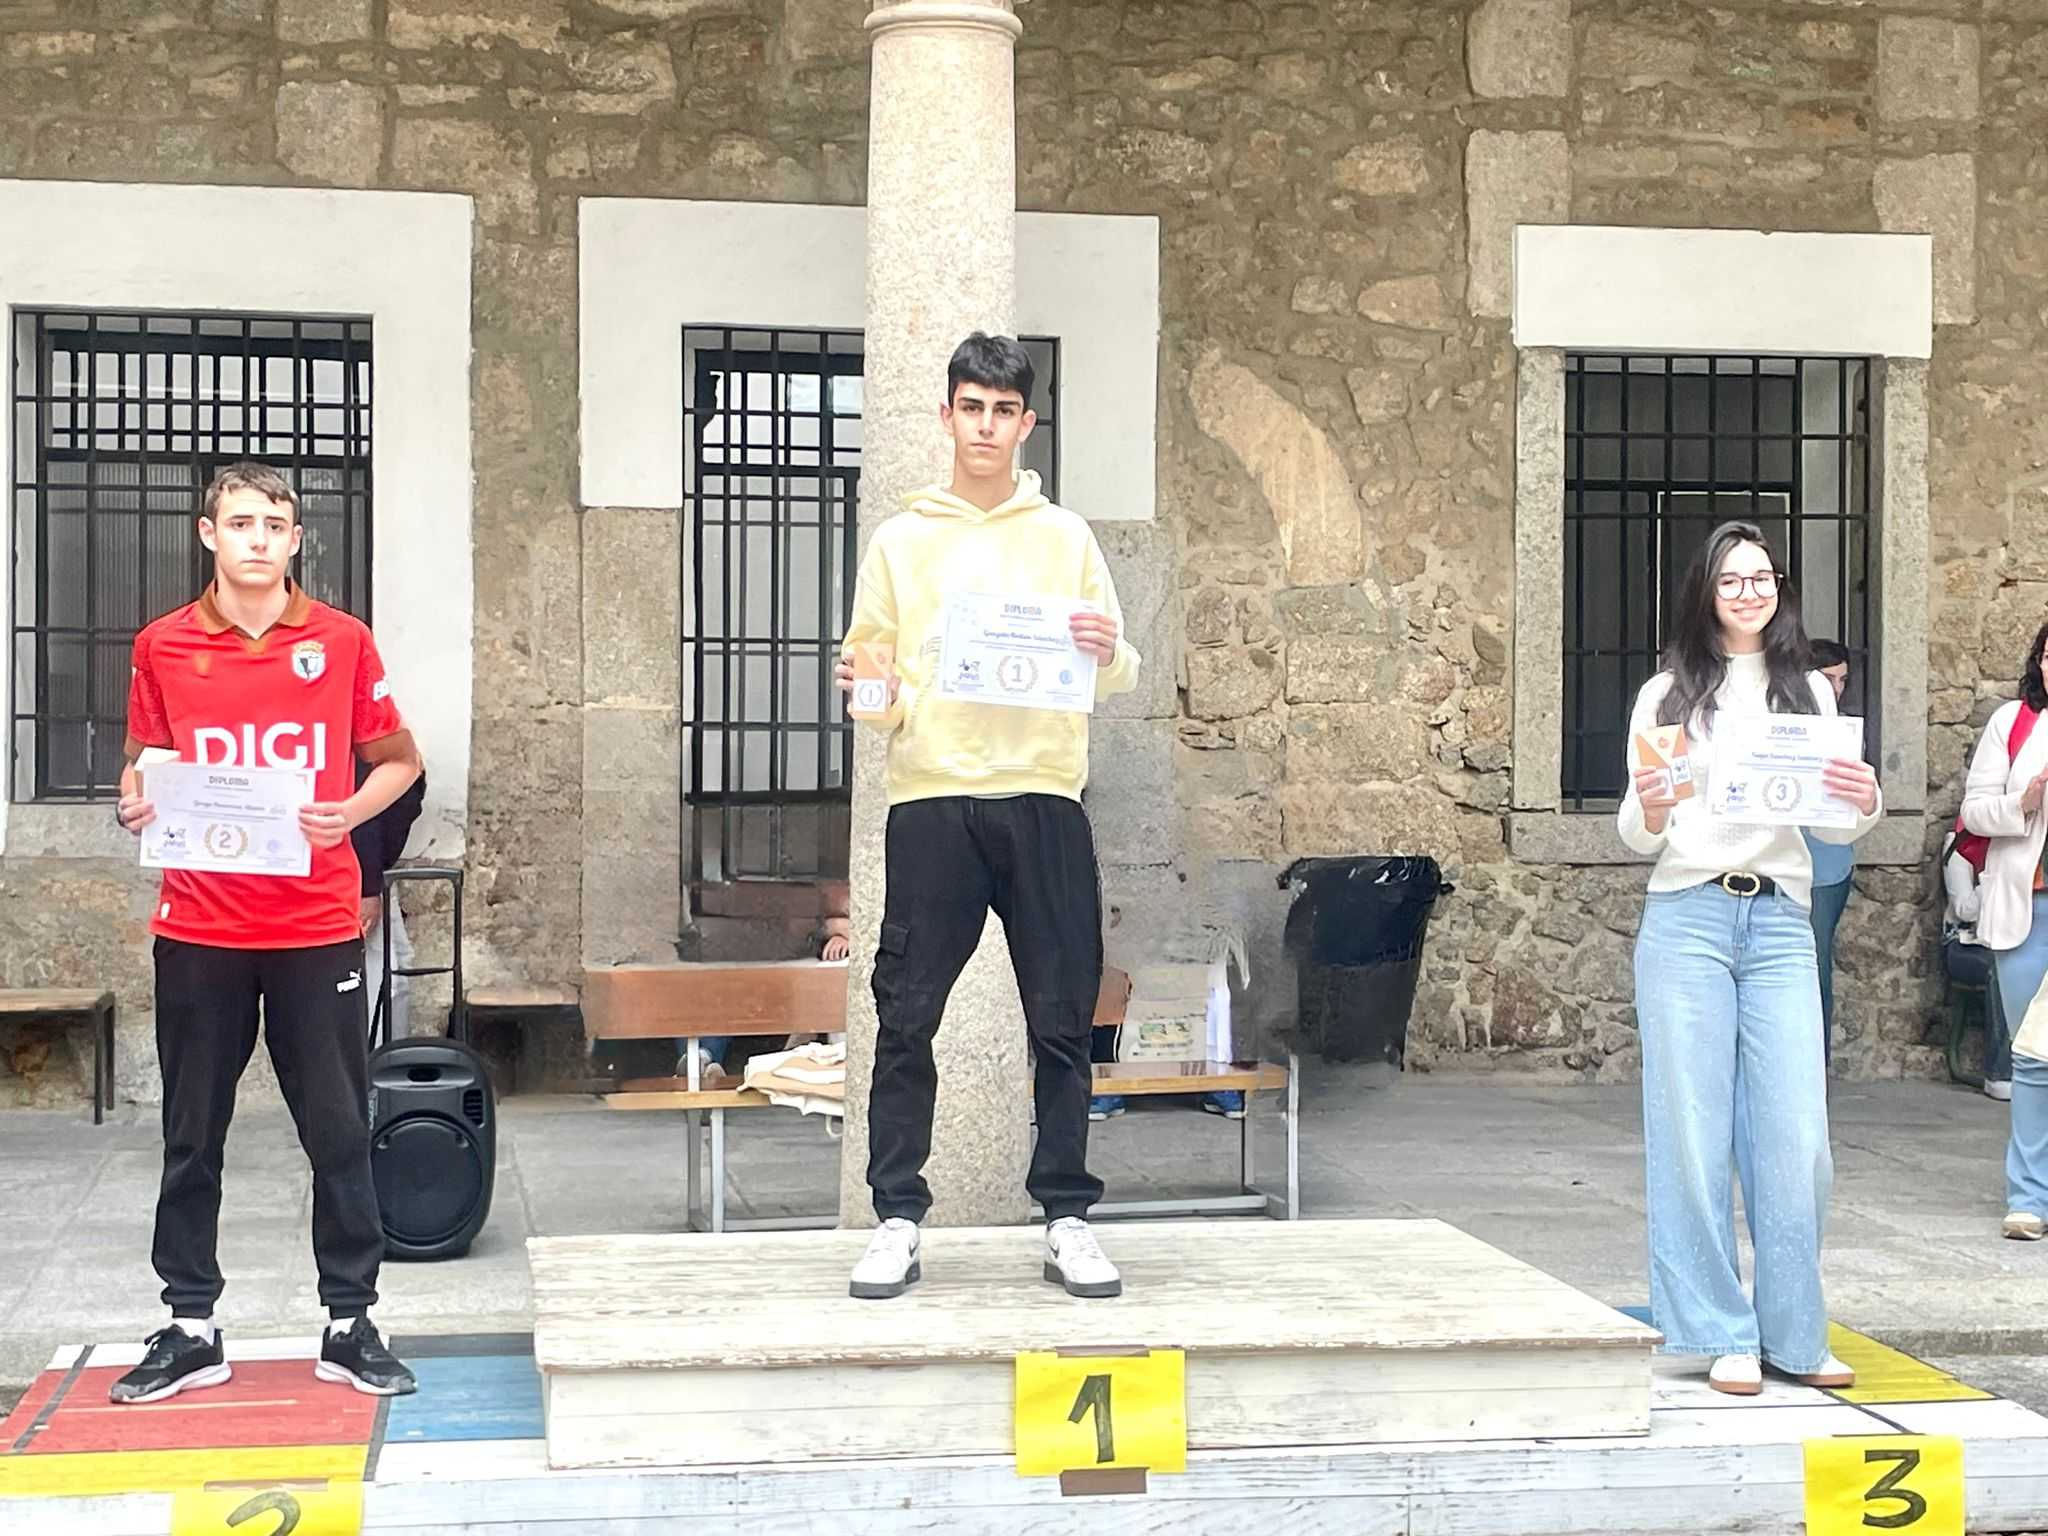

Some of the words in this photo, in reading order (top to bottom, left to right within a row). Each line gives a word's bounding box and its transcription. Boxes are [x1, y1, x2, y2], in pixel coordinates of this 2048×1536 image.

[1011, 663, 1022, 682] 1
[194, 722, 326, 771] DIGI
[208, 775, 249, 786] DIPLOMA
[1776, 783, 1787, 801] 3
[219, 830, 231, 849] 2
[1067, 1374, 1115, 1464] 1
[1862, 1448, 1927, 1529] 3
